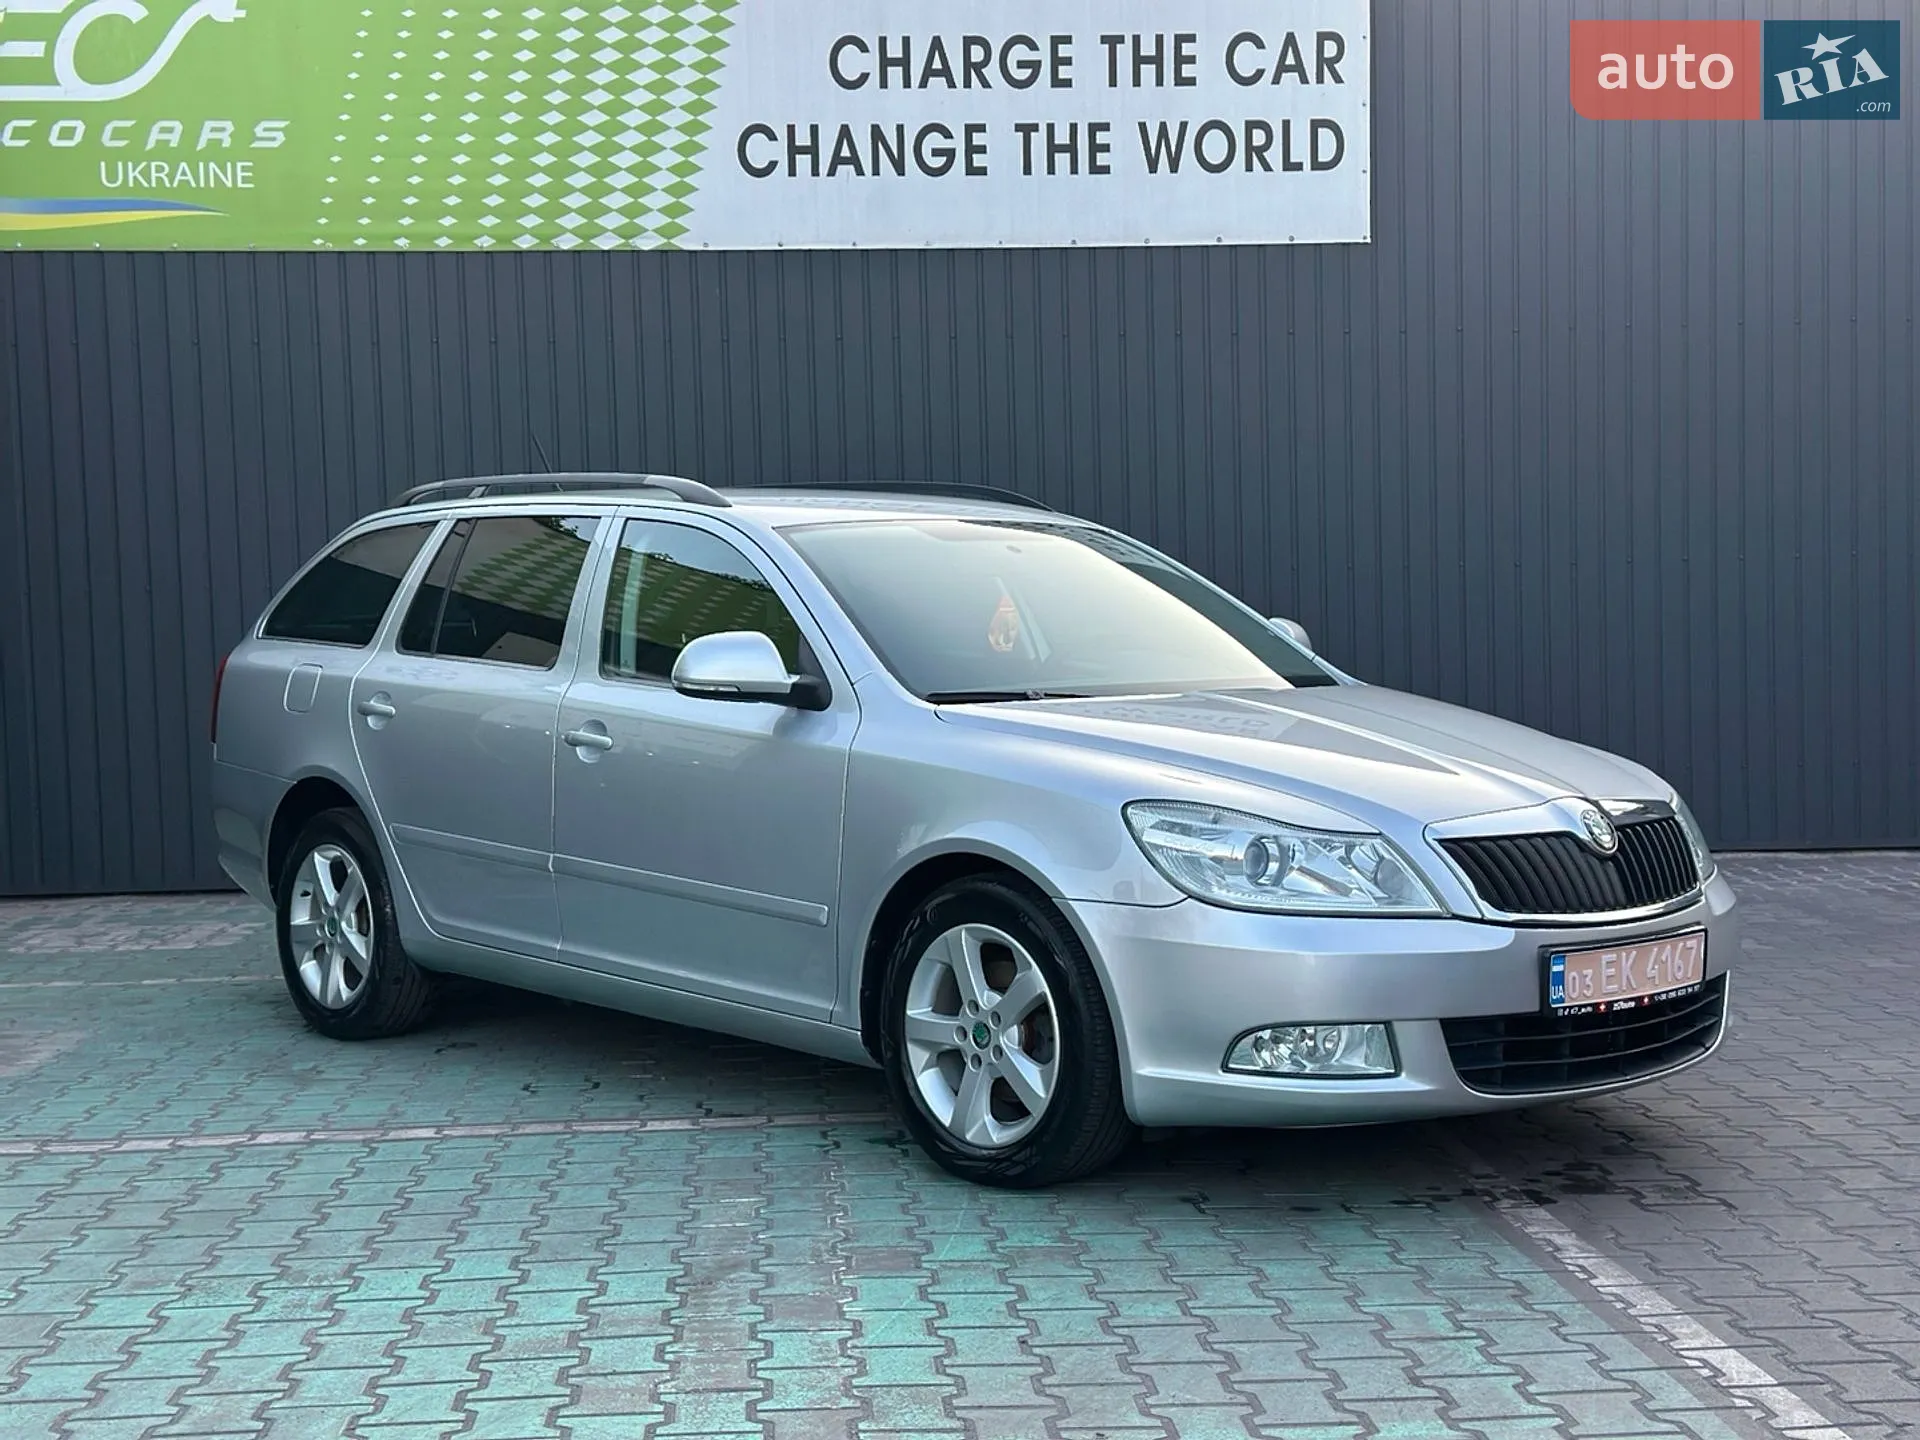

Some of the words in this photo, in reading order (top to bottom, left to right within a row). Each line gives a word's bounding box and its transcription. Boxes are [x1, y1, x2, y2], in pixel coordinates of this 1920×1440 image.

[829, 34, 1074, 90] CHARGE
[1100, 33, 1198, 88] THE
[1225, 31, 1346, 87] CAR
[100, 161, 255, 188] UKRAINE
[737, 122, 989, 179] CHANGE
[1014, 121, 1111, 176] THE
[1138, 118, 1346, 175] WORLD
[1551, 984, 1565, 1000] UA
[1568, 968, 1594, 1000] 03
[1601, 950, 1637, 994] EK
[1646, 939, 1699, 985] 4167
